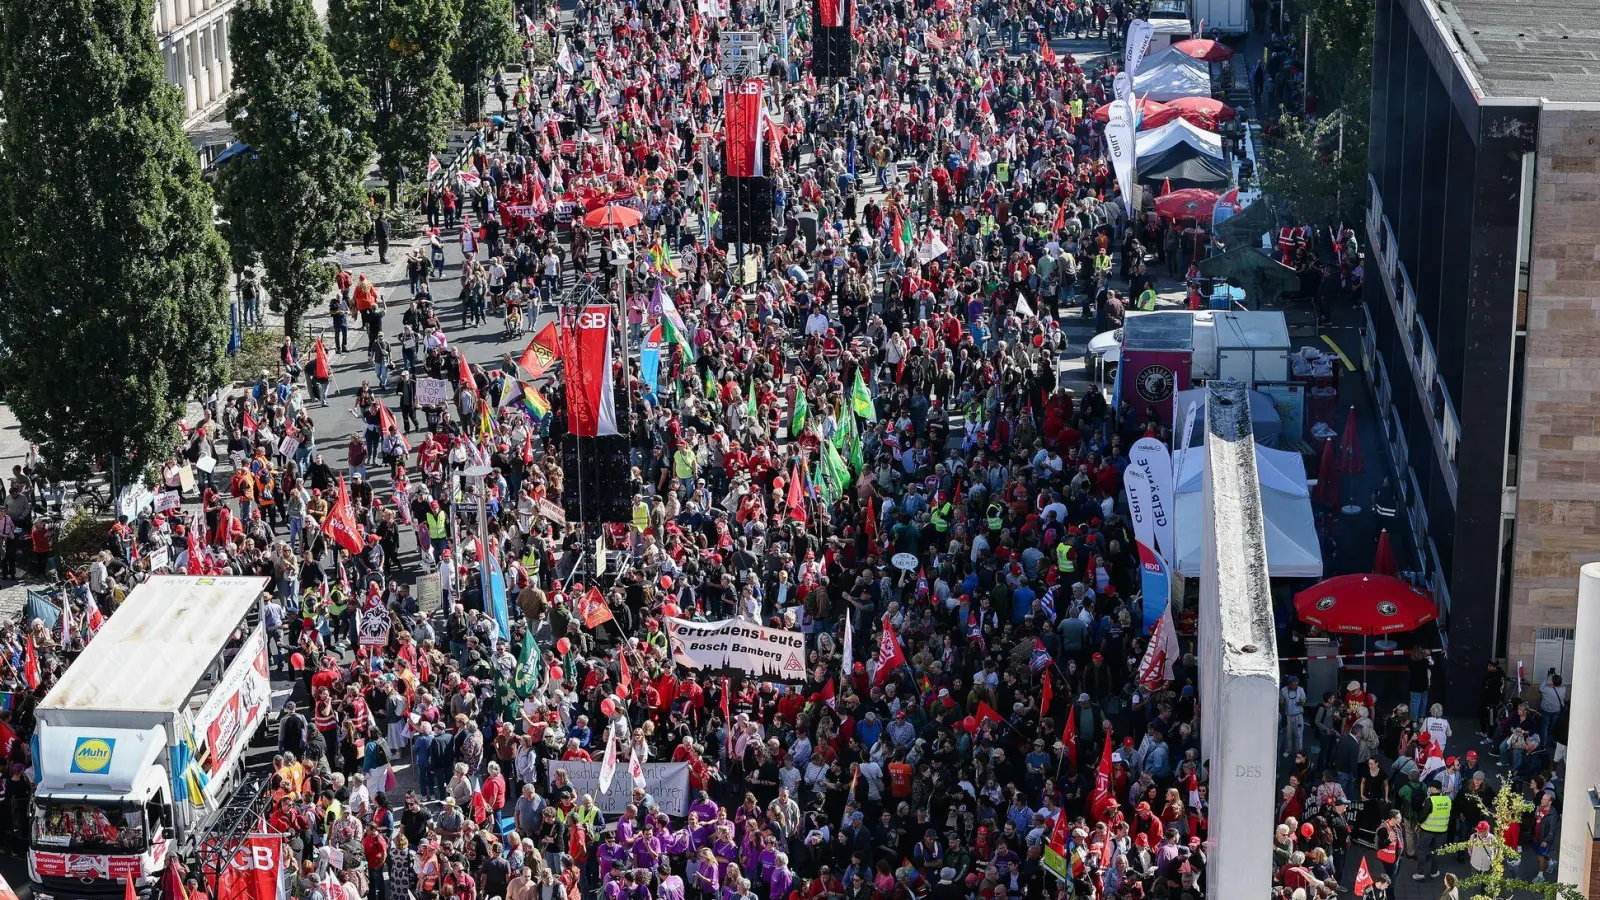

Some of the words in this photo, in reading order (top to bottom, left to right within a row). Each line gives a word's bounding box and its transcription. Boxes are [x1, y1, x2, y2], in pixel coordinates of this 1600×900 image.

[668, 623, 803, 648] VertrauensLeute
[690, 642, 728, 651] Bosch
[731, 643, 782, 661] Bamberg
[78, 747, 108, 757] Muhr
[1235, 764, 1262, 777] DES
